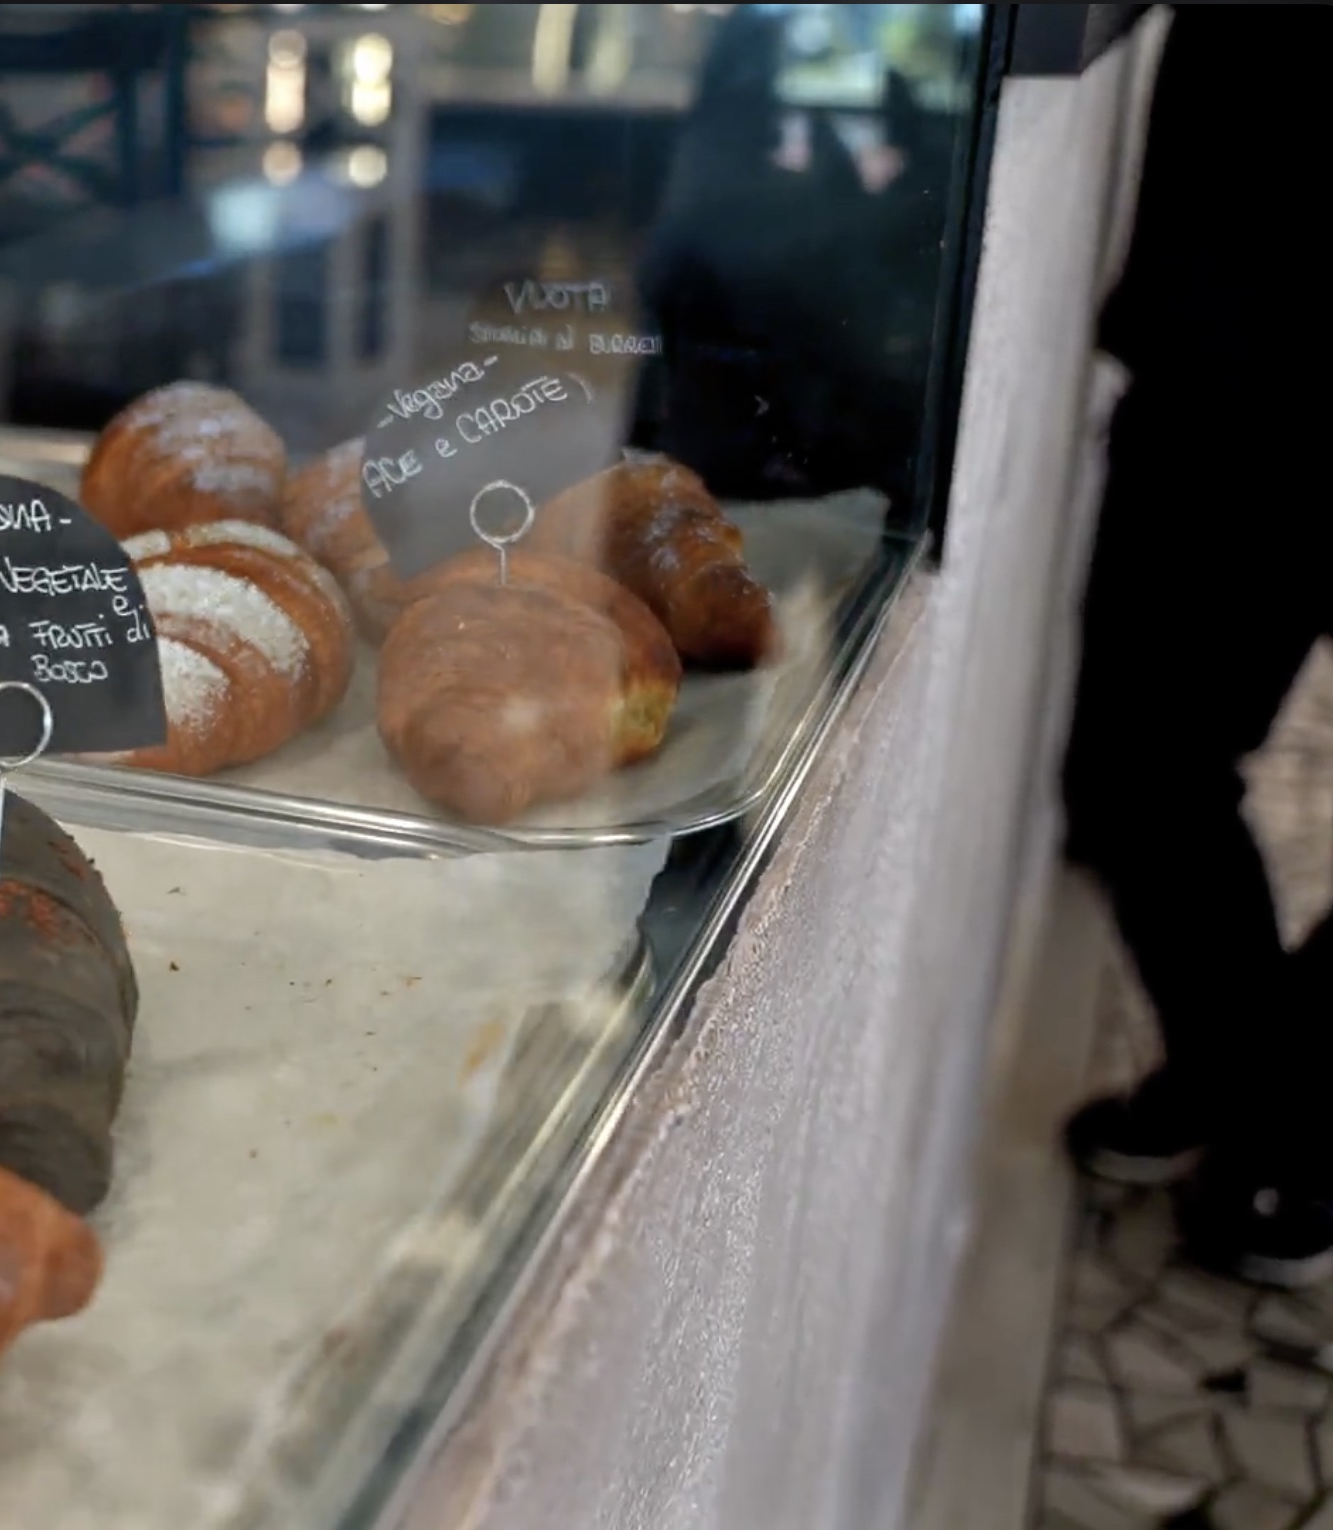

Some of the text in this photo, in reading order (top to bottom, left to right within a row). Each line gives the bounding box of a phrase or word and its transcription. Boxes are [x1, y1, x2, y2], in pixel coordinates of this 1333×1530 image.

[362, 375, 568, 500] ACE e CAROTE
